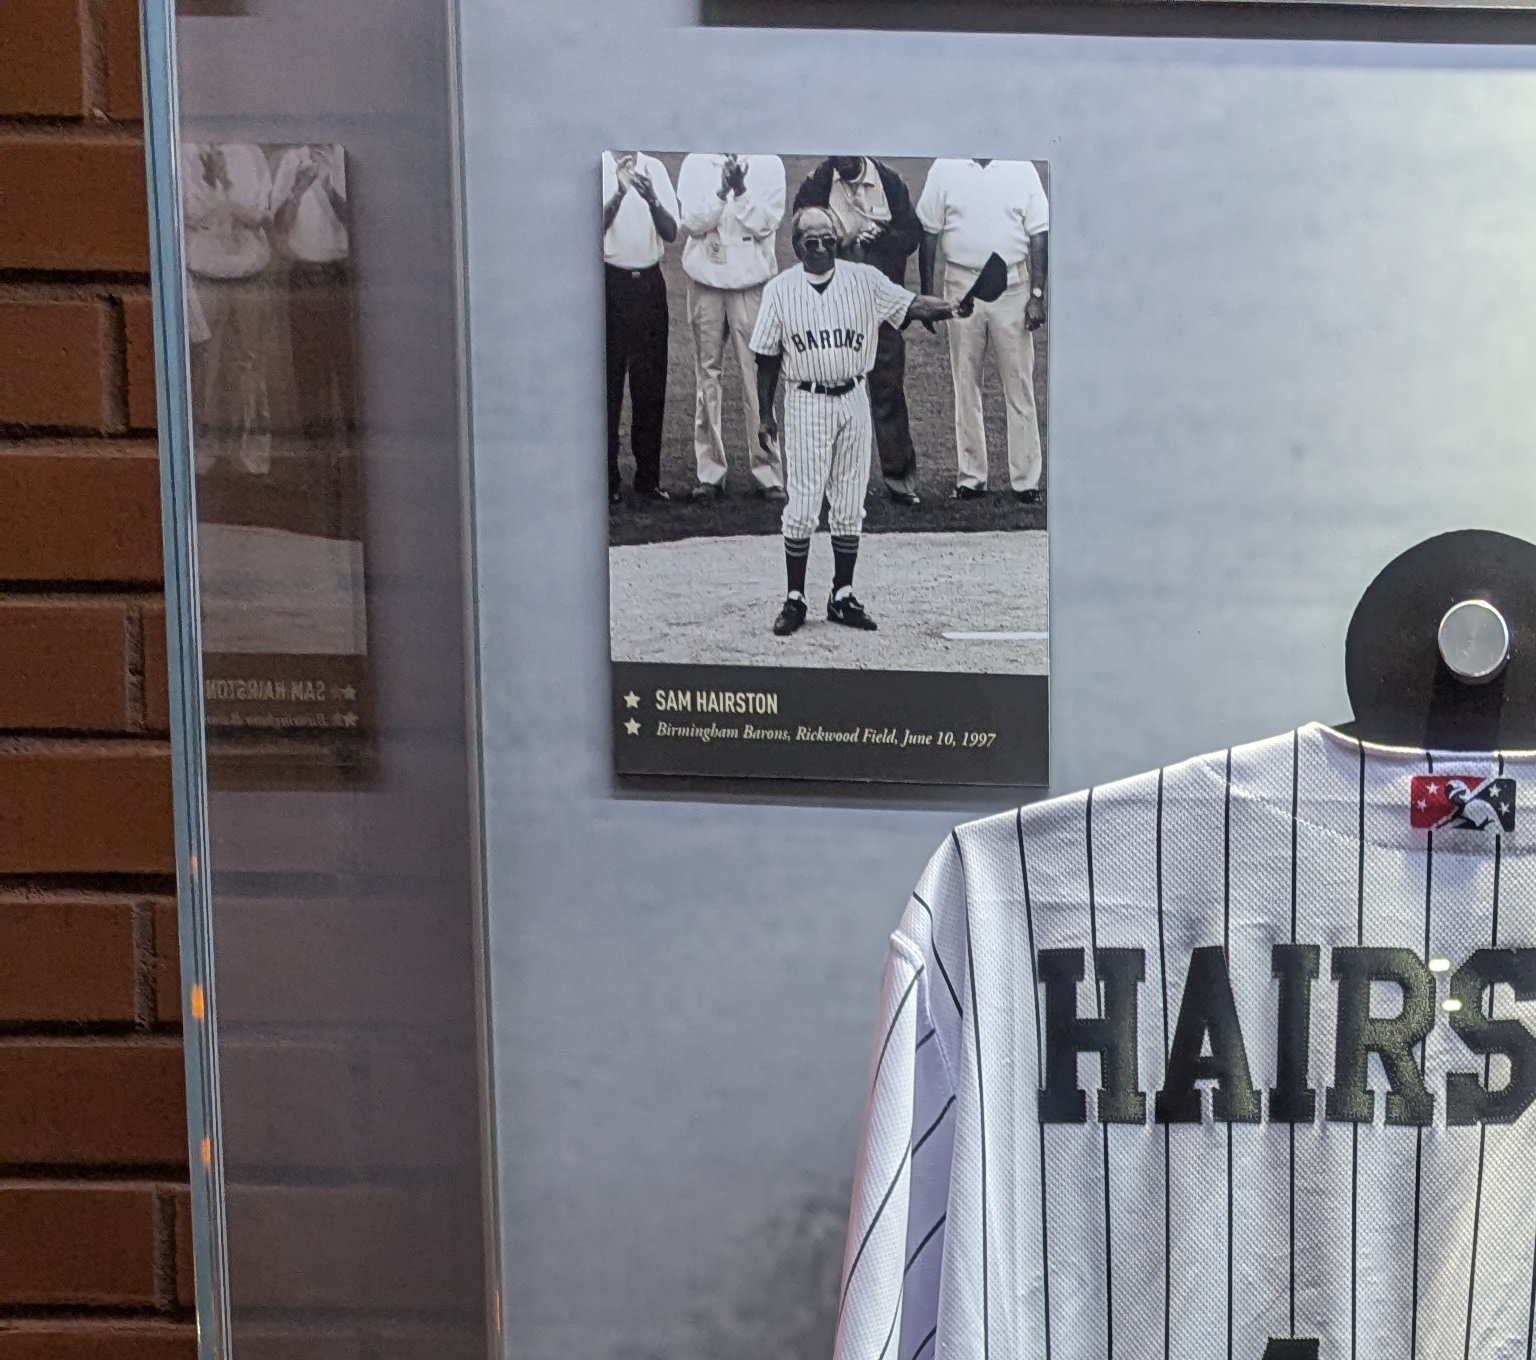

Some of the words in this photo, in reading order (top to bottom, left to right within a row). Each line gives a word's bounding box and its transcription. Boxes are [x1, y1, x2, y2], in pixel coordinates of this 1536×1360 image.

[791, 328, 865, 354] BARONS
[656, 690, 691, 712] SAM
[697, 691, 778, 715] HAIRSTON
[657, 722, 738, 743] Birmingham
[743, 724, 790, 743] Barons,
[796, 726, 859, 744] Rickwood
[862, 728, 898, 746] Field,
[900, 730, 932, 748] June
[936, 732, 956, 748] 10,
[961, 732, 996, 748] 1997
